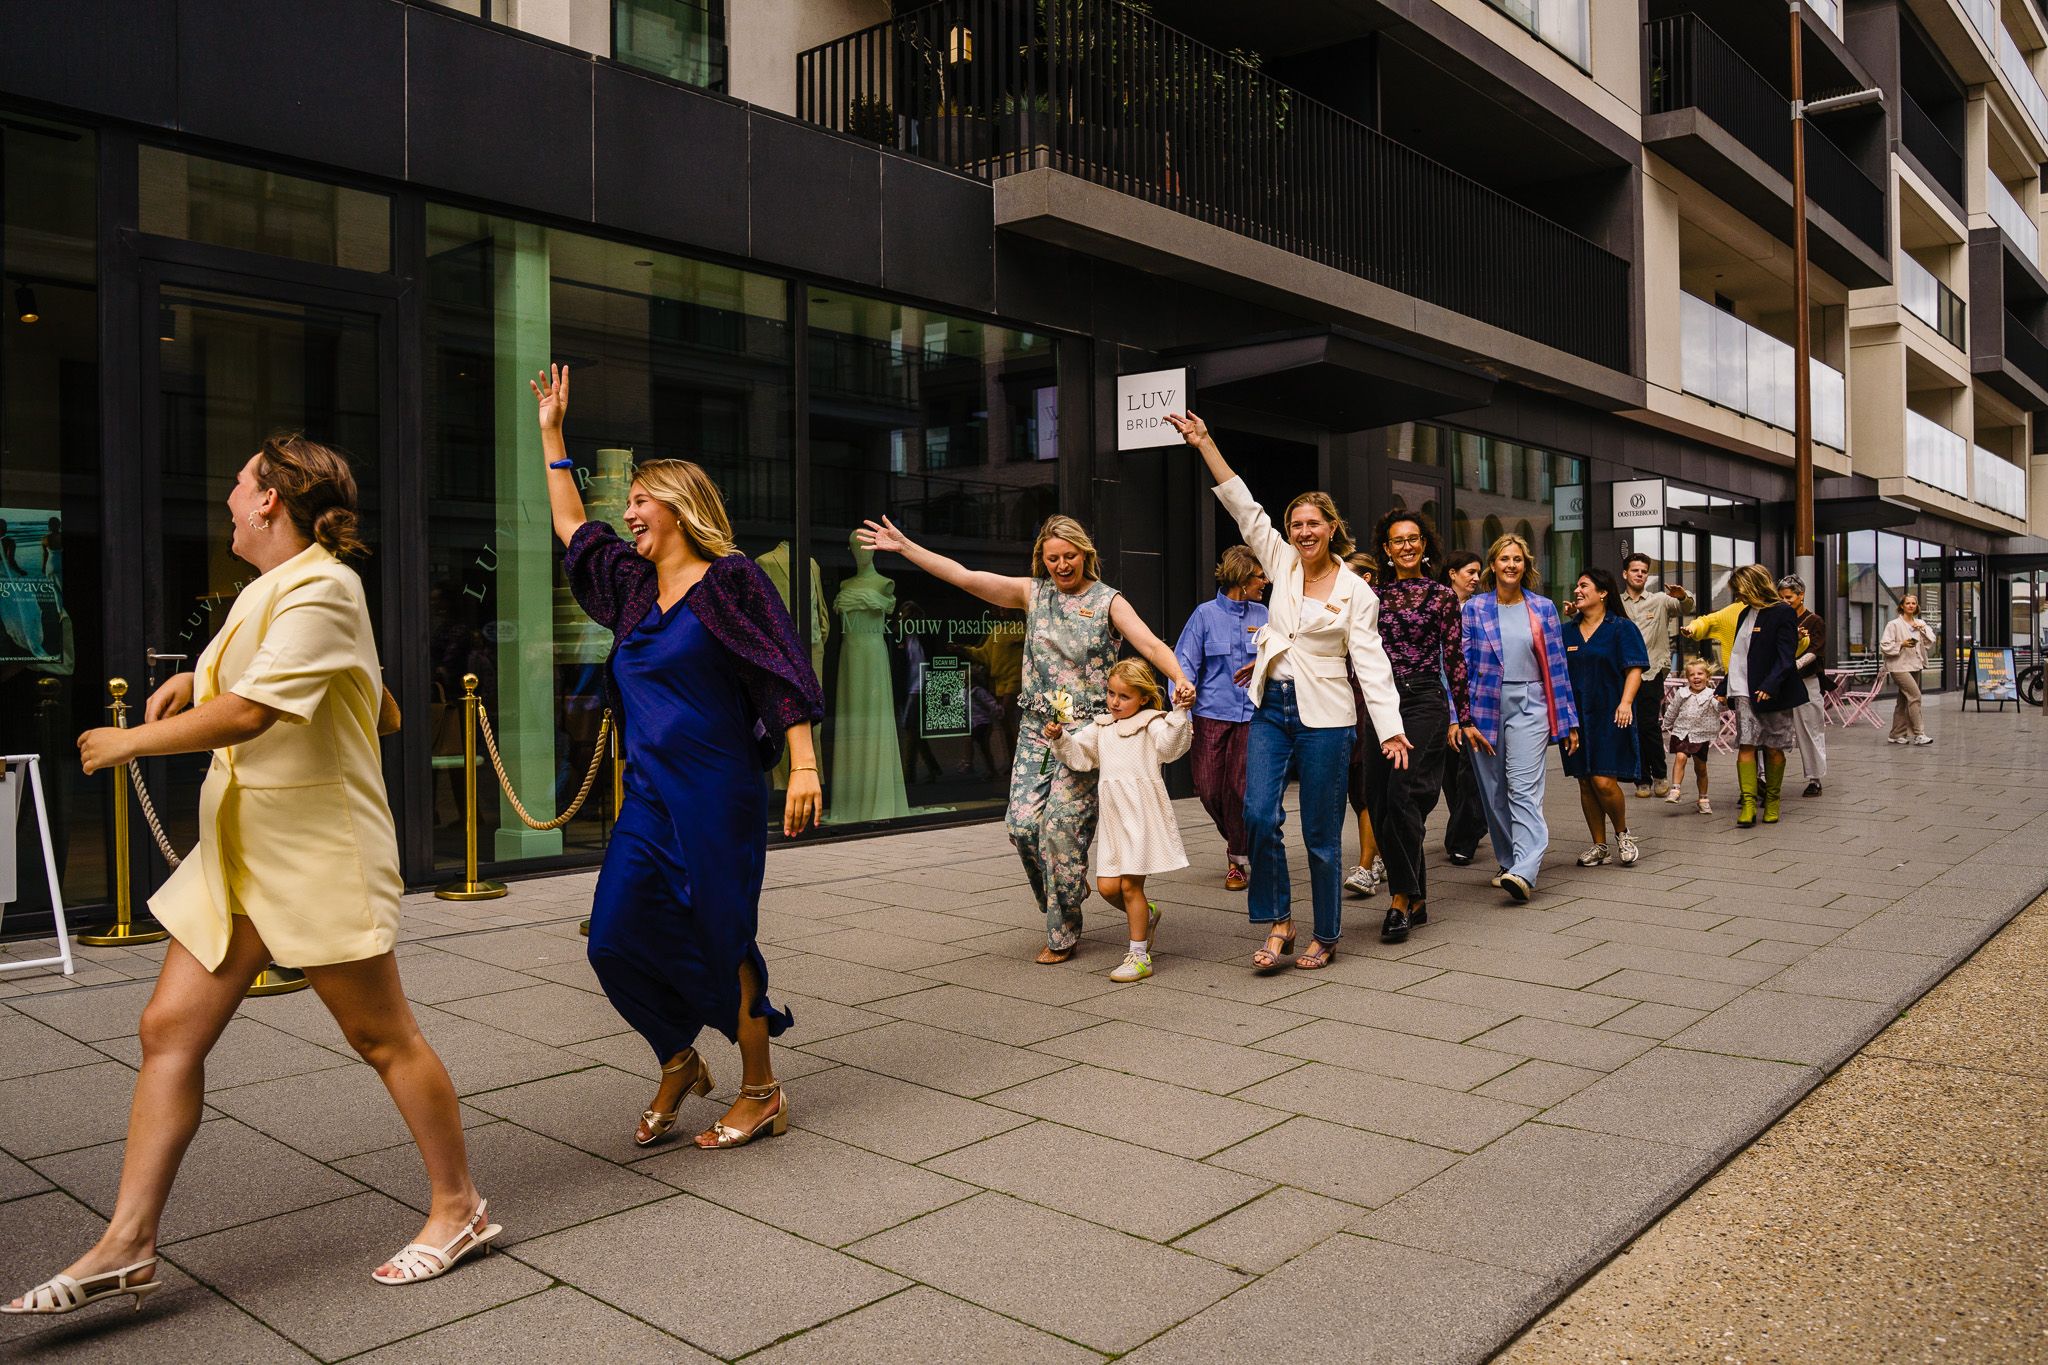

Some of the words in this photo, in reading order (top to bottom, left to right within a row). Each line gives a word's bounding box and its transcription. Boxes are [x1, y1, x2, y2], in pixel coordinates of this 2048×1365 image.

[1126, 416, 1174, 431] BRIDA
[1617, 509, 1659, 518] OOSTERBROOD
[896, 612, 945, 643] jouw
[948, 610, 1026, 643] pasafspraa
[934, 658, 948, 667] SCAN
[948, 658, 957, 667] ME
